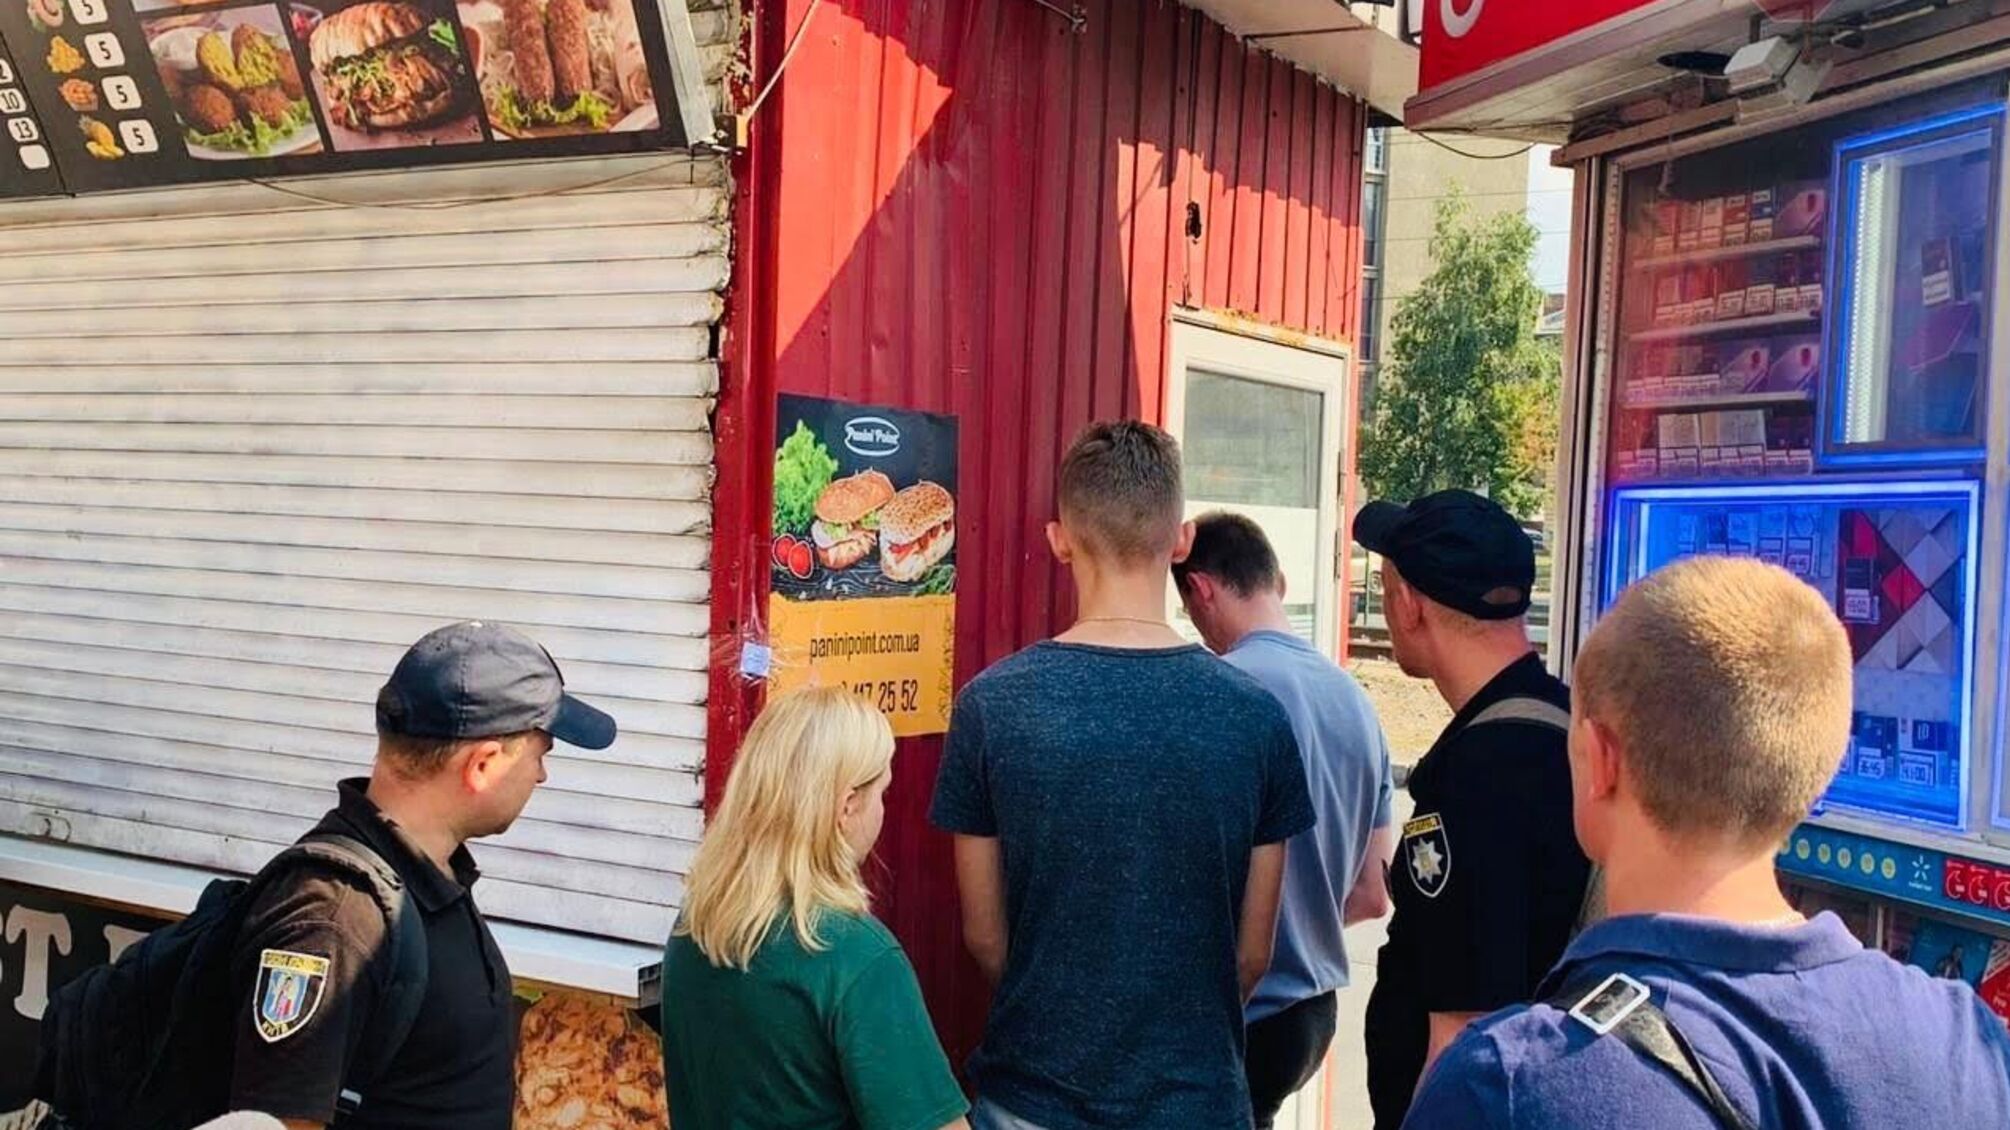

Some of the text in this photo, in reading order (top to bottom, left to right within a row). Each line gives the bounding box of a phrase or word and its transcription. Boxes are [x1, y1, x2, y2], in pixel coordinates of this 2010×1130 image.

[98, 41, 112, 60] 5
[1, 91, 20, 110] 10
[115, 84, 128, 104] 5
[15, 120, 34, 139] 13
[132, 127, 145, 147] 5
[809, 631, 920, 665] paninipoint.com.ua
[878, 681, 896, 714] 25
[901, 679, 918, 712] 52
[0, 903, 72, 1022] T
